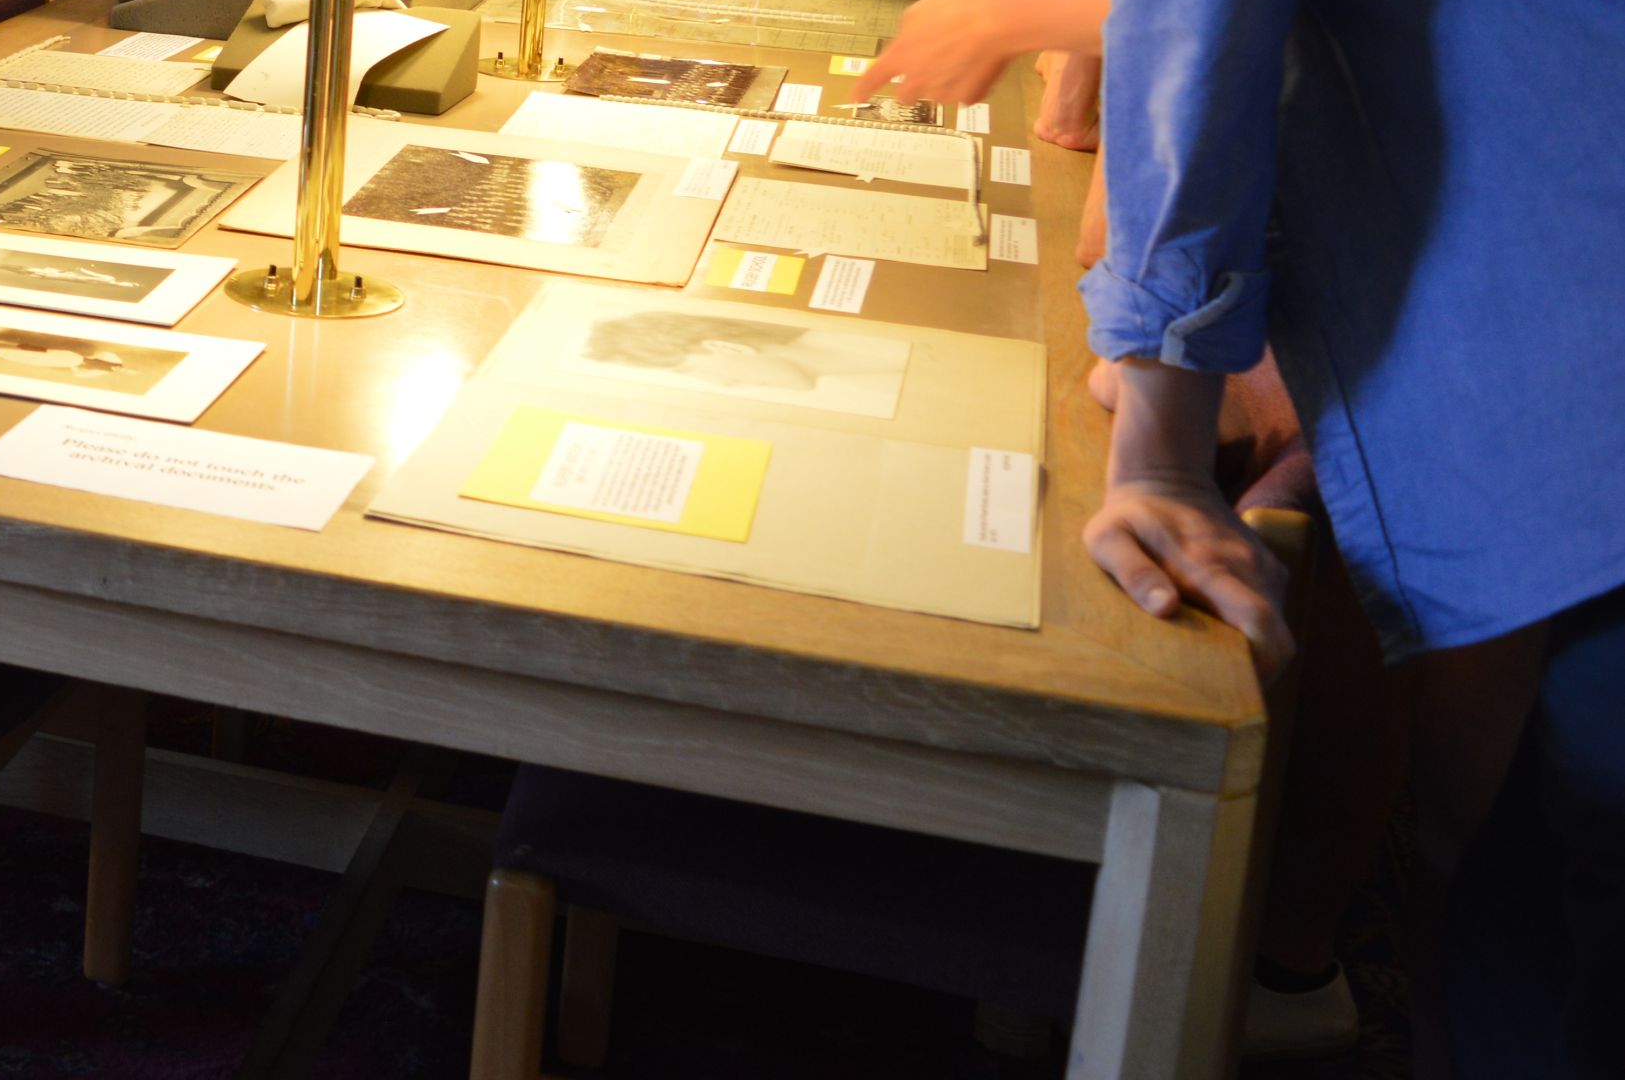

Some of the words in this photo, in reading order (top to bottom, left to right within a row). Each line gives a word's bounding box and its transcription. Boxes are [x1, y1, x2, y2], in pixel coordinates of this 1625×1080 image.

[61, 438, 128, 457] Please
[132, 450, 159, 462] do
[163, 455, 200, 469] not
[203, 461, 265, 479] touch
[269, 472, 306, 486] the
[67, 451, 155, 472] archival
[157, 465, 276, 491] documents
